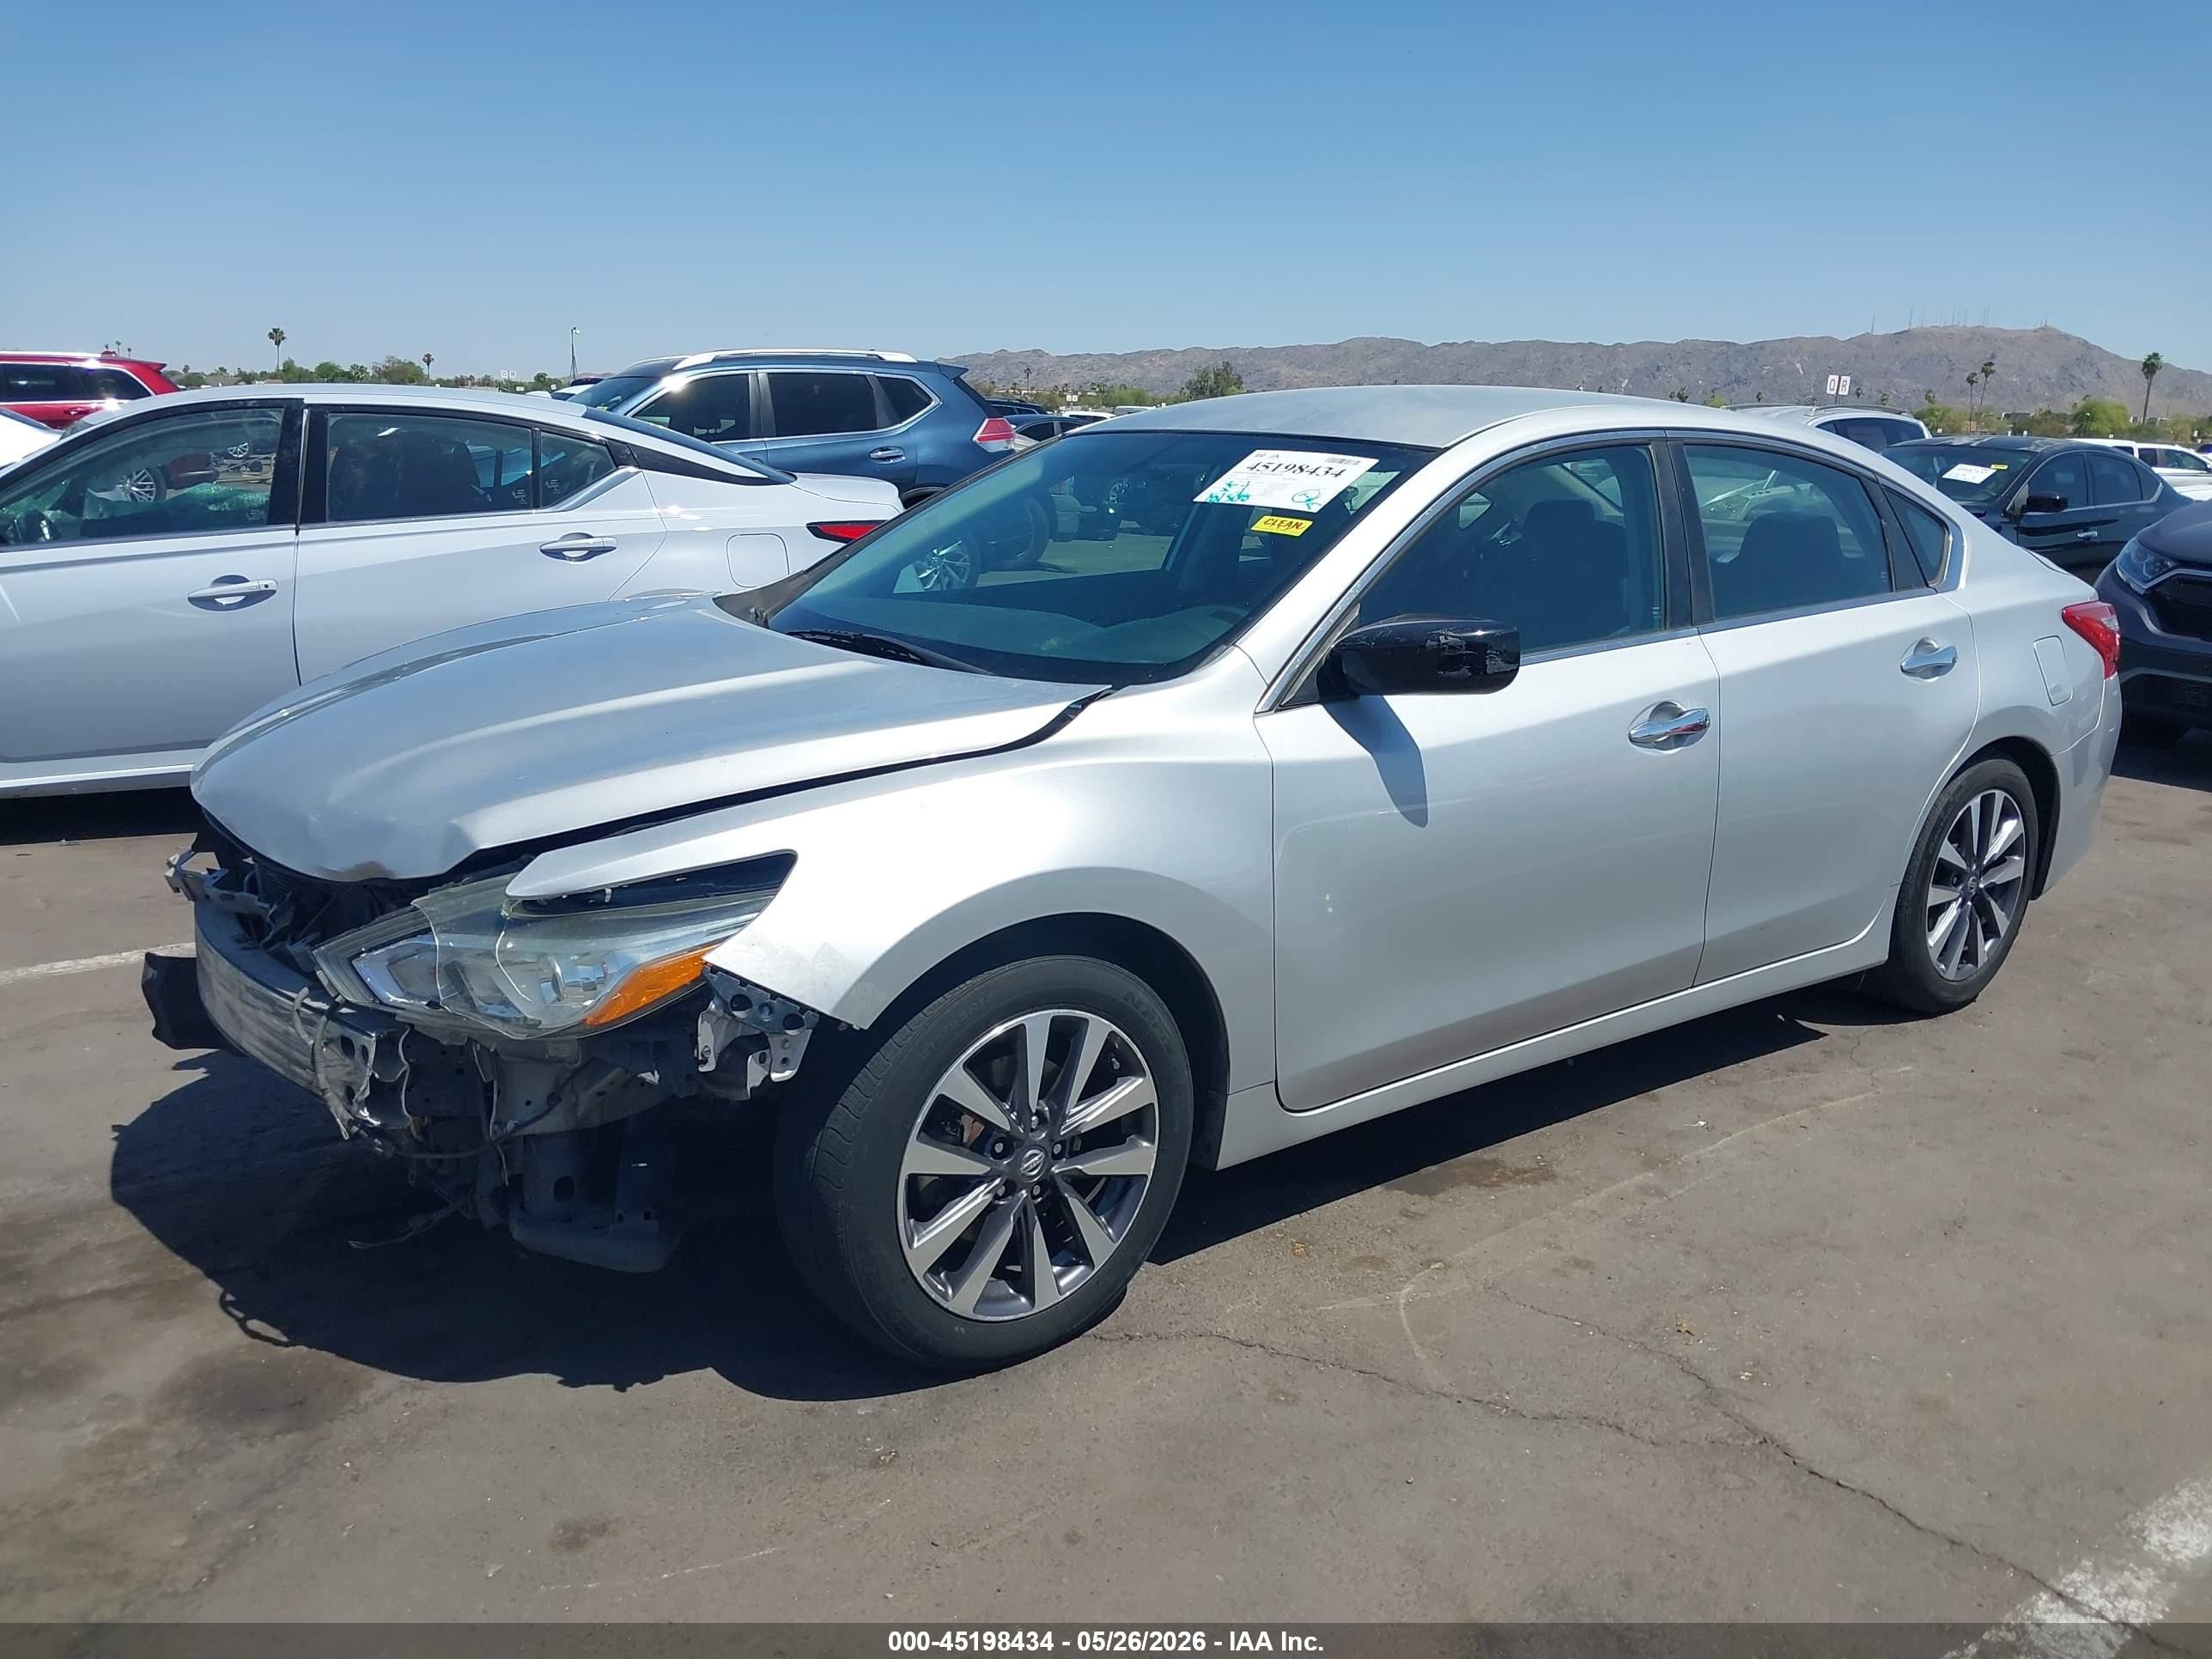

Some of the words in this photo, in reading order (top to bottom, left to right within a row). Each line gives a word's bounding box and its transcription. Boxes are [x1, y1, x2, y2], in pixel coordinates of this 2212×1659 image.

[1829, 378, 1836, 392] Q
[1840, 380, 1848, 392] R
[1246, 461, 1347, 478] 45198434
[1263, 518, 1304, 531] CLEAN
